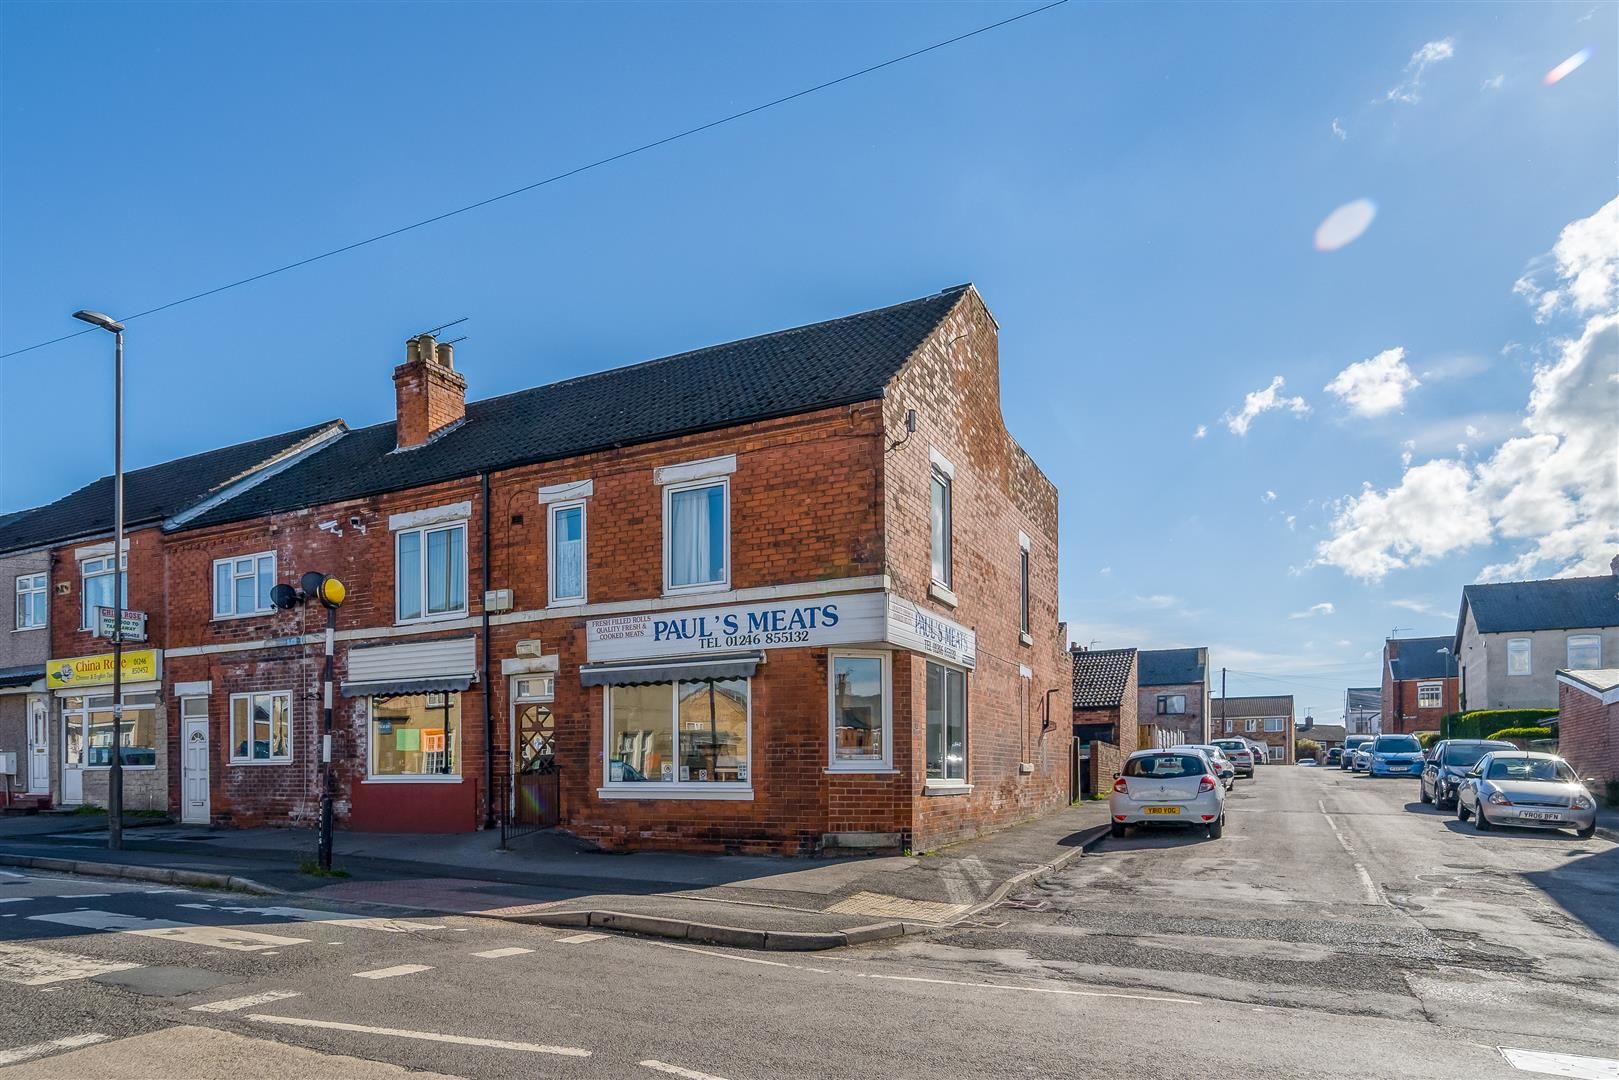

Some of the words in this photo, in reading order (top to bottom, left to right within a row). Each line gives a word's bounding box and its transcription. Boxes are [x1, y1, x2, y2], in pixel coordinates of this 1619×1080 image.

[124, 612, 142, 620] ROSE
[653, 614, 739, 641] PAUL'S
[747, 605, 839, 633] MEATS
[596, 624, 620, 634] QUALITY
[600, 632, 624, 640] COOKED
[916, 614, 943, 642] PAUL'S
[945, 626, 968, 652] MEATS
[698, 637, 721, 649] TEL
[726, 634, 761, 647] 01246
[765, 631, 809, 644] 855132
[76, 660, 100, 672] China
[103, 658, 127, 670] Roe
